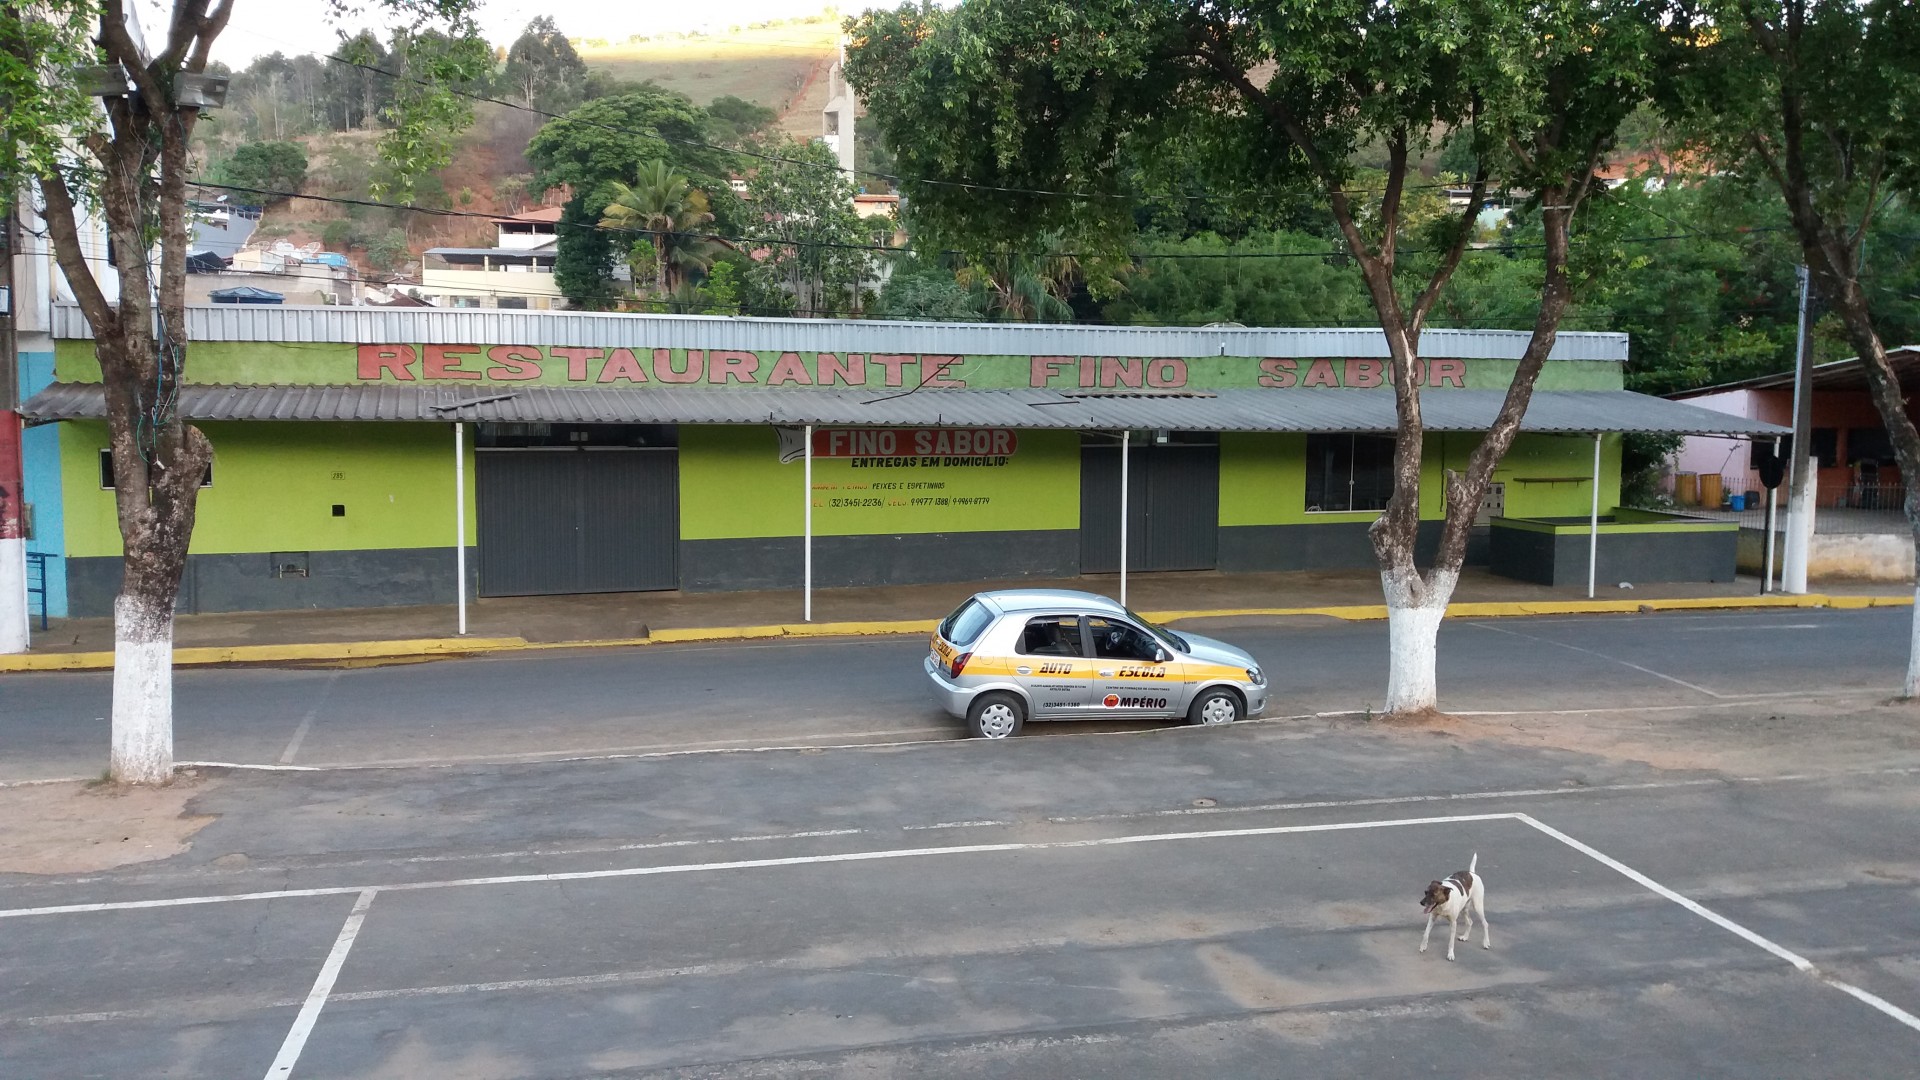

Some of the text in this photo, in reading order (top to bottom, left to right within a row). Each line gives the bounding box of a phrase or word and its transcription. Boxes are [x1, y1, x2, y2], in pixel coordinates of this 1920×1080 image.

[357, 345, 966, 388] RESTAURANTE
[1030, 355, 1188, 388] FINO
[830, 430, 1010, 455] FINO SABOR
[851, 456, 917, 468] ENTREGAS
[921, 456, 939, 467] EM
[872, 482, 897, 490] PEIXES
[899, 482, 904, 490] E
[1039, 662, 1166, 678] AUTO ESCOLA
